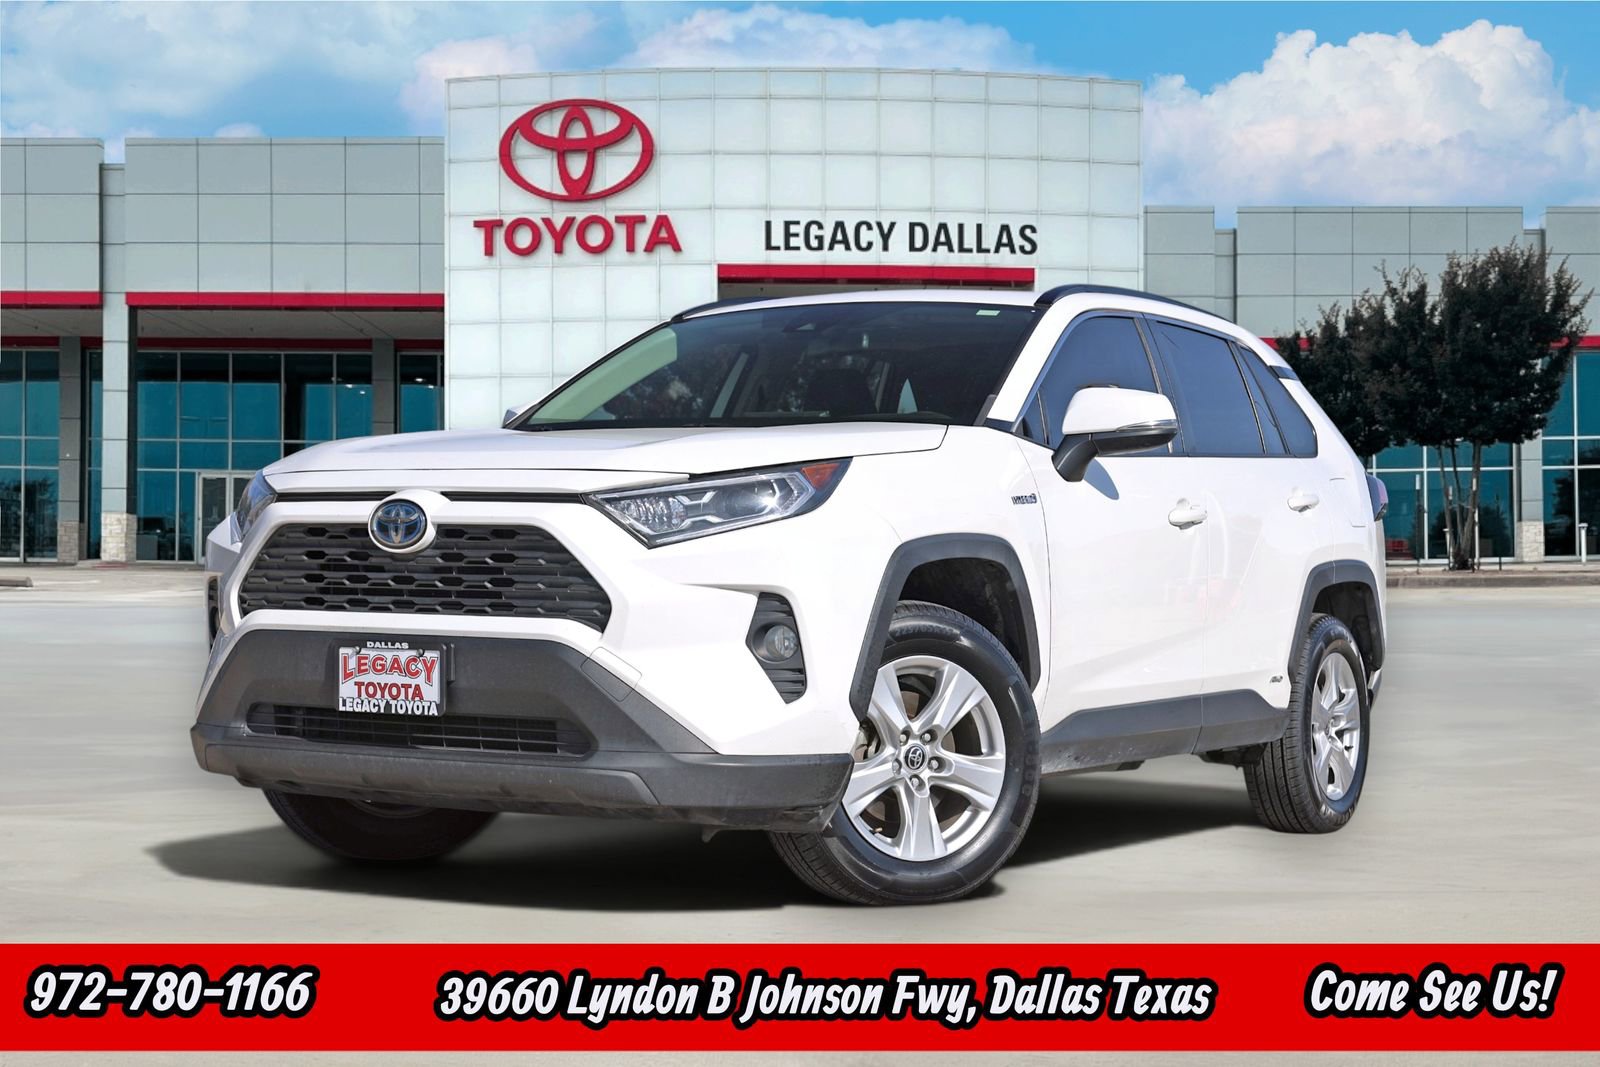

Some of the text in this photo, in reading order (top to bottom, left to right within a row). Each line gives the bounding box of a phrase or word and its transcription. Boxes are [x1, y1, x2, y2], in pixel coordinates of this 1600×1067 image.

[474, 214, 682, 256] TOYOTA
[765, 220, 1038, 255] LEGACY DALLAS
[366, 641, 409, 649] DALLAS
[340, 653, 438, 686] LEGACY
[354, 681, 424, 700] TOYOTA
[338, 697, 438, 716] LEGACY TOYOTA
